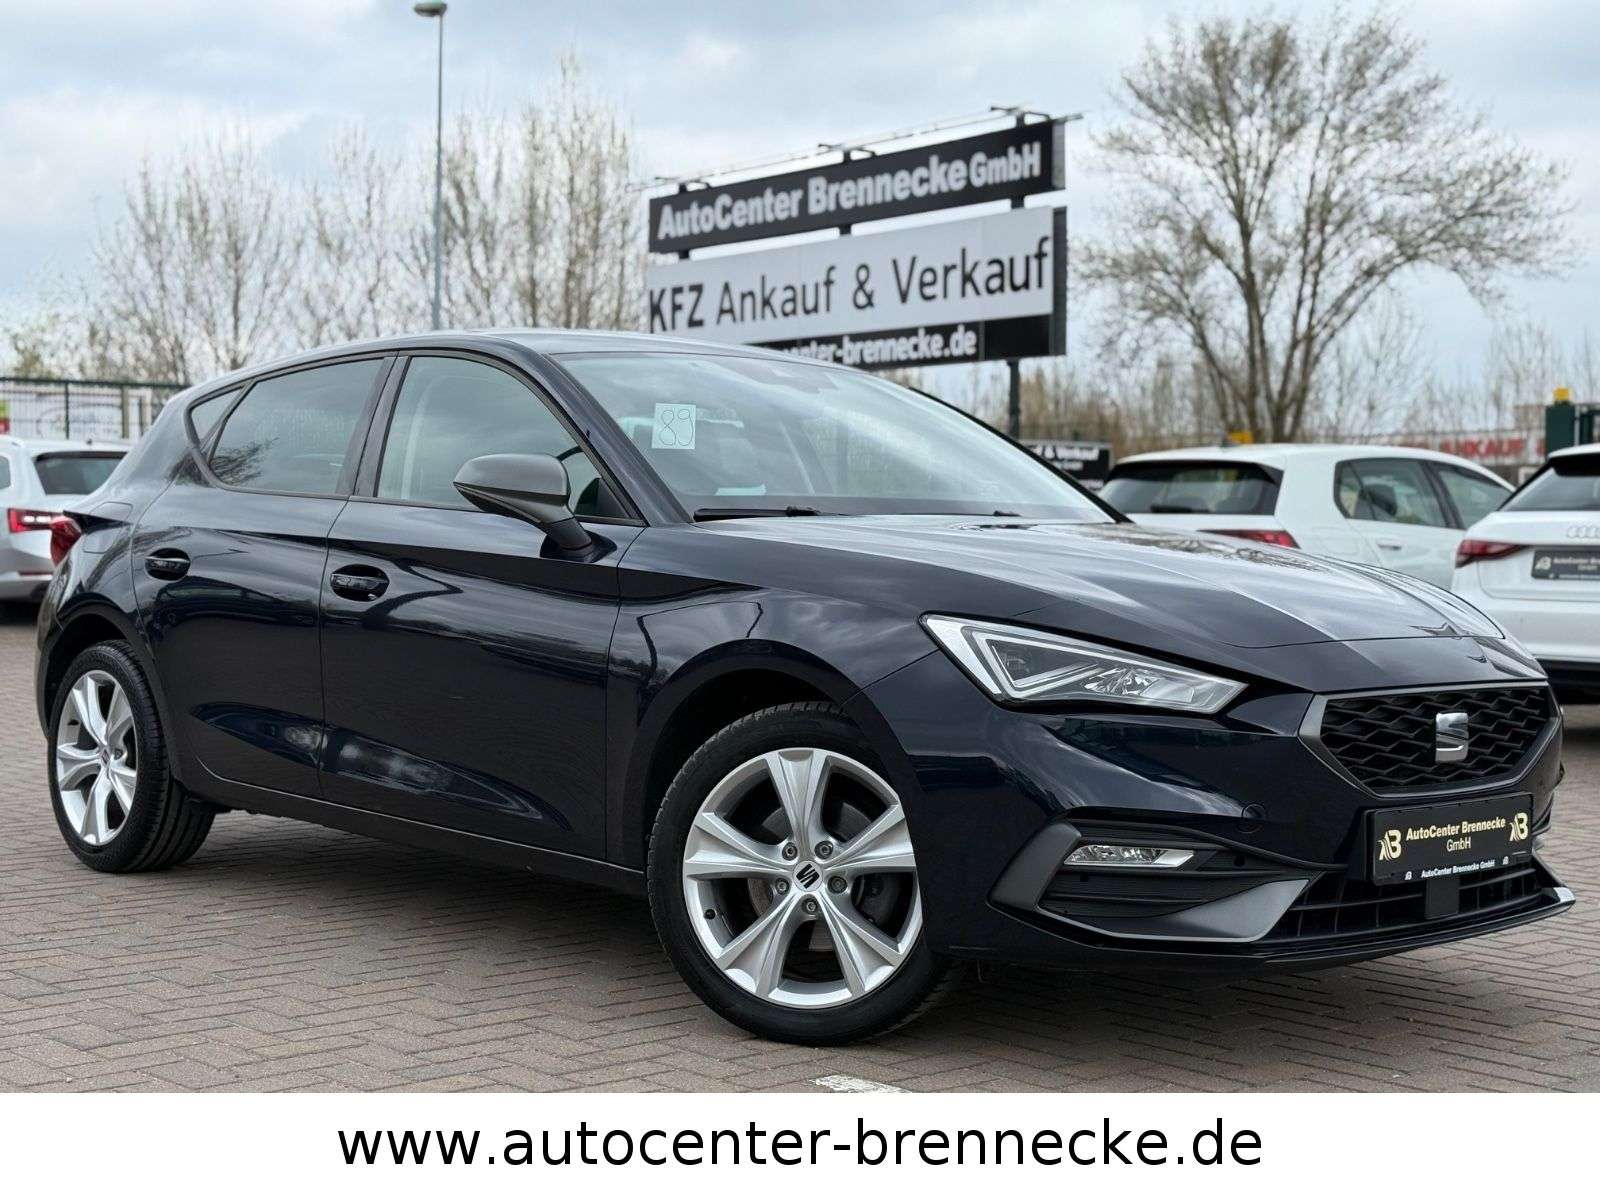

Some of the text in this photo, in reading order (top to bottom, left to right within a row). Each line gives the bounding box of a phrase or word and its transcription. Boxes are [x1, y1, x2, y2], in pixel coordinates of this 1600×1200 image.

[657, 141, 1041, 240] AutoCenter Brennecke GmbH
[649, 236, 1050, 334] KFZ Ankauf & Verkauf
[658, 408, 694, 446] 89
[1406, 816, 1506, 841] AutoCenter Brennecke
[1446, 836, 1471, 852] GmbH
[1421, 866, 1452, 879] AutoCenter
[1452, 862, 1479, 874] Brennecke
[1480, 859, 1496, 869] GmbH
